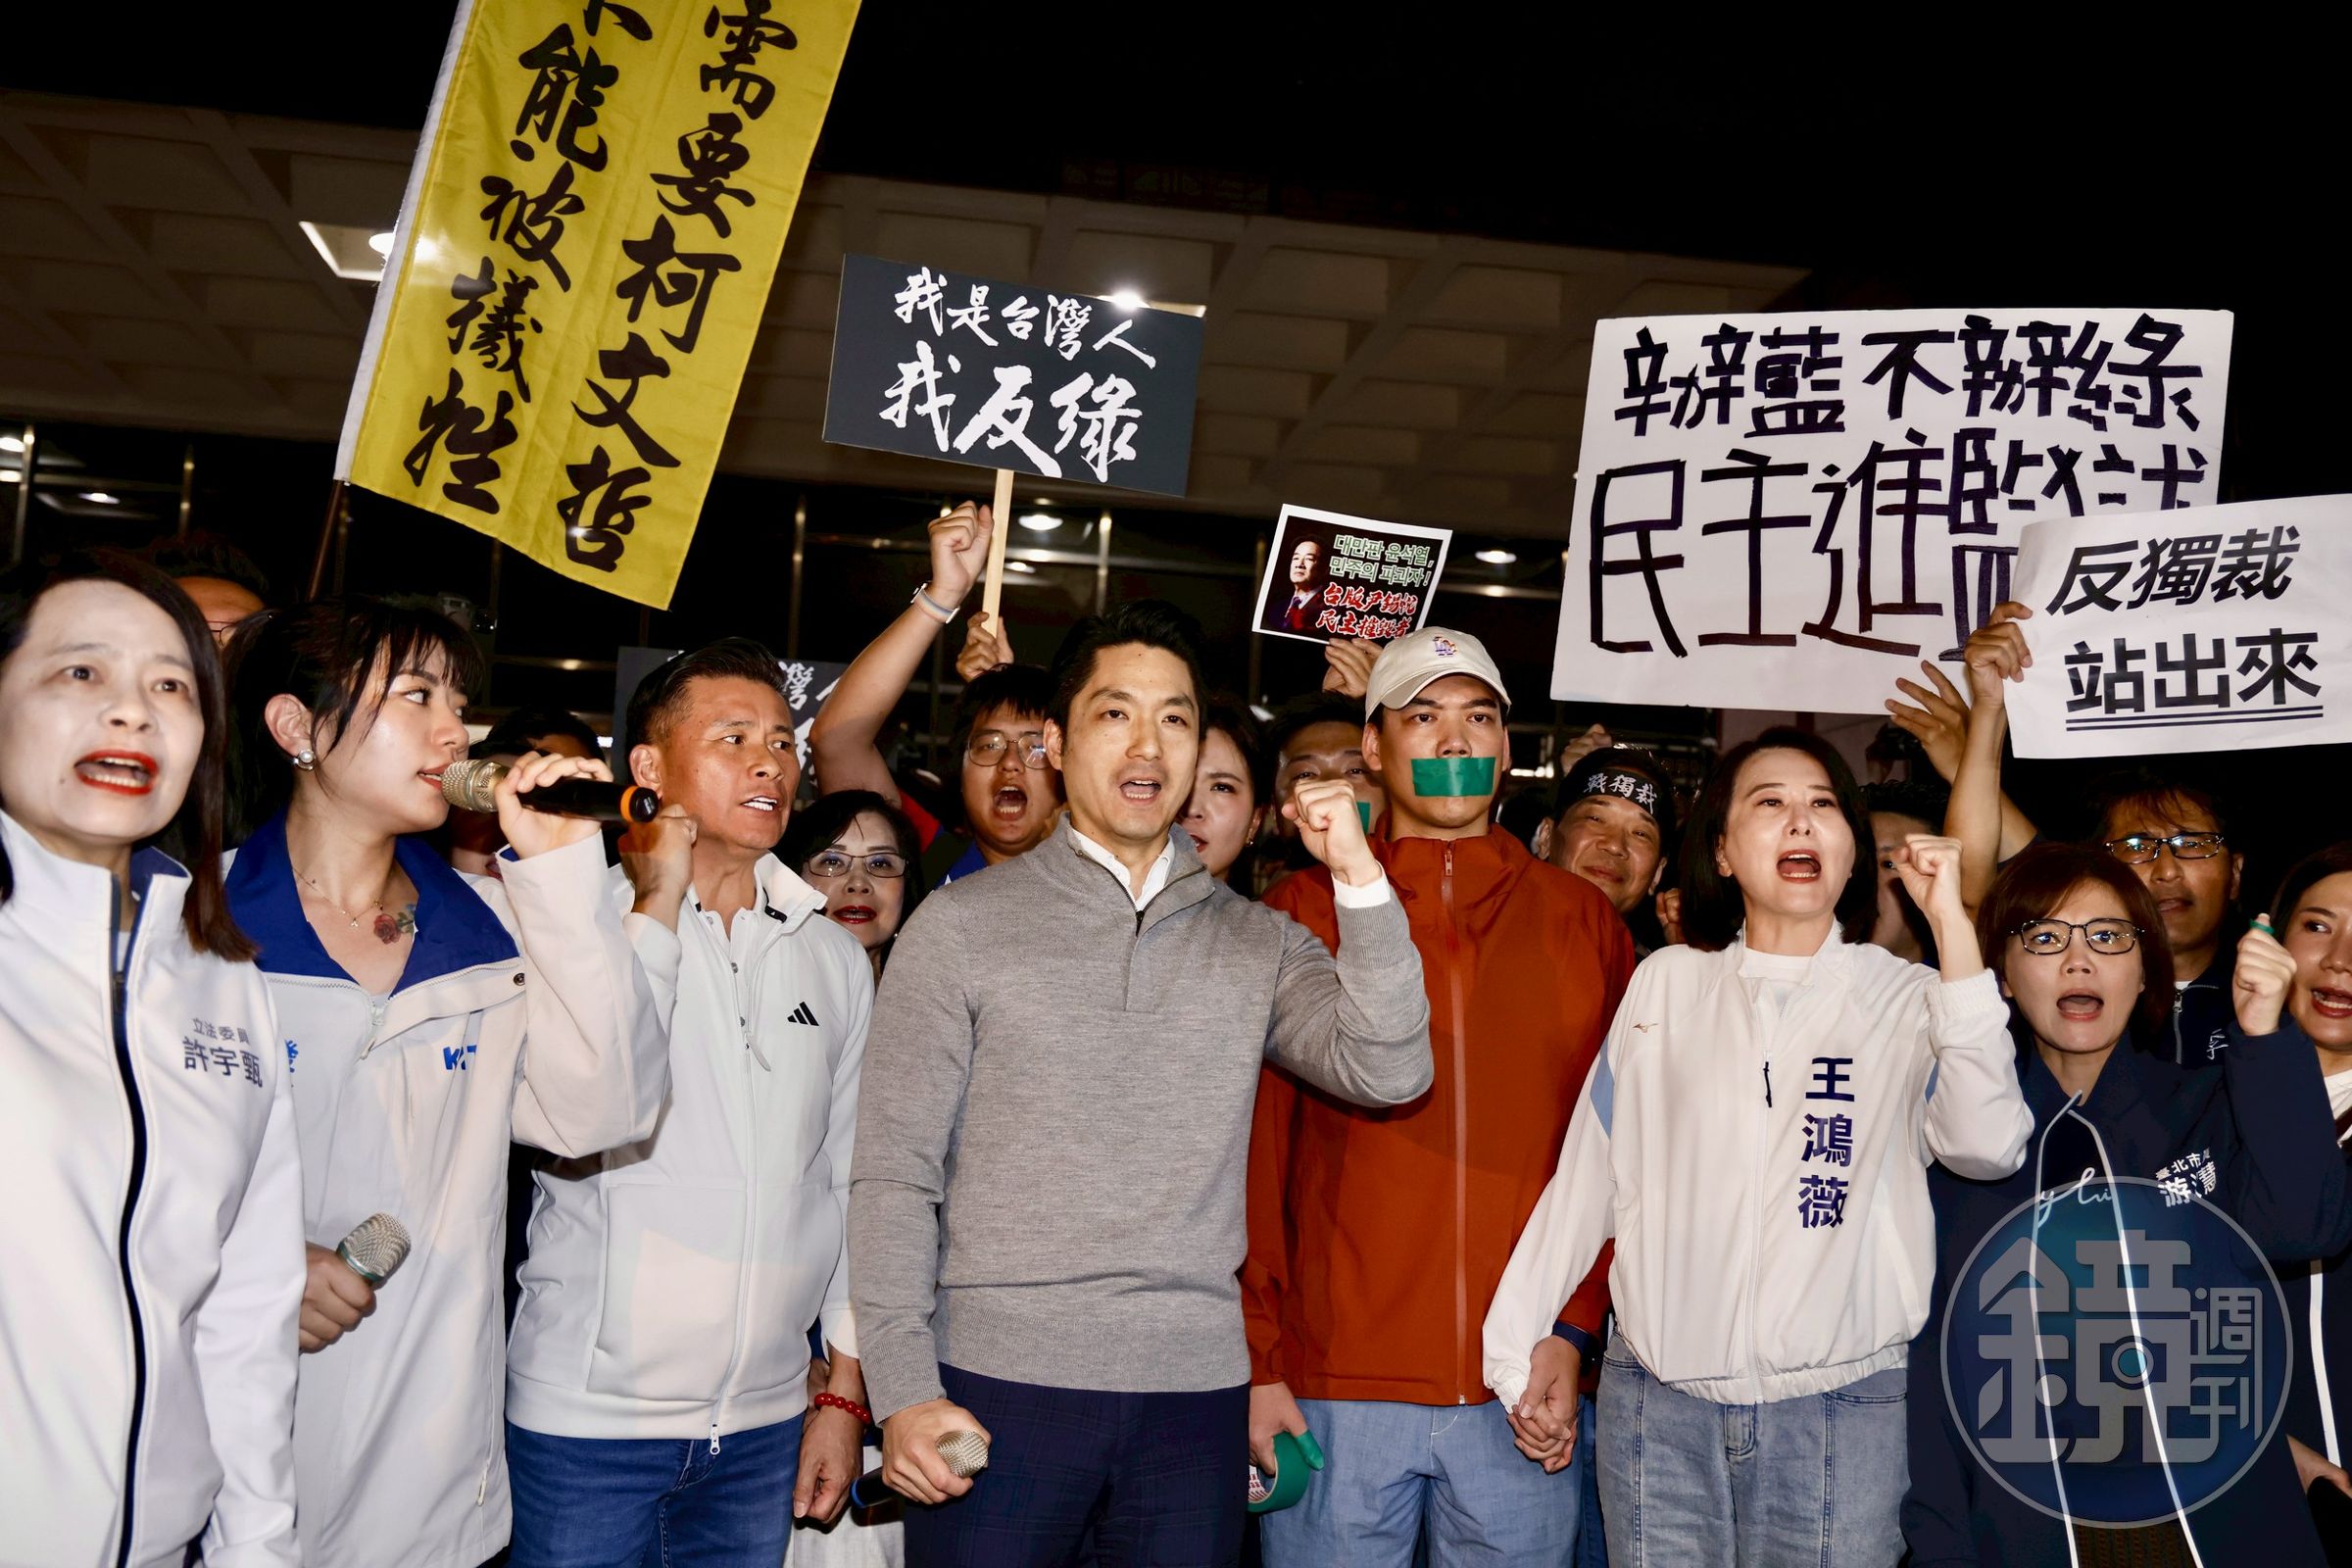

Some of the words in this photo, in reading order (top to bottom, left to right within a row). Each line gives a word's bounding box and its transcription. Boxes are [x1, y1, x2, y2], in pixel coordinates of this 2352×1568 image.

[557, 0, 798, 573] 需要柯文哲
[894, 267, 1156, 369] 我是台灣人
[879, 340, 1143, 482] 我反綠
[1329, 556, 1379, 582] 민주의
[1334, 534, 1385, 560] 대만판
[2045, 524, 2301, 616] 反獨裁
[2064, 627, 2322, 714] 站出來
[182, 1036, 263, 1088] 許宇甄
[1797, 1056, 1855, 1229] 王鴻薇
